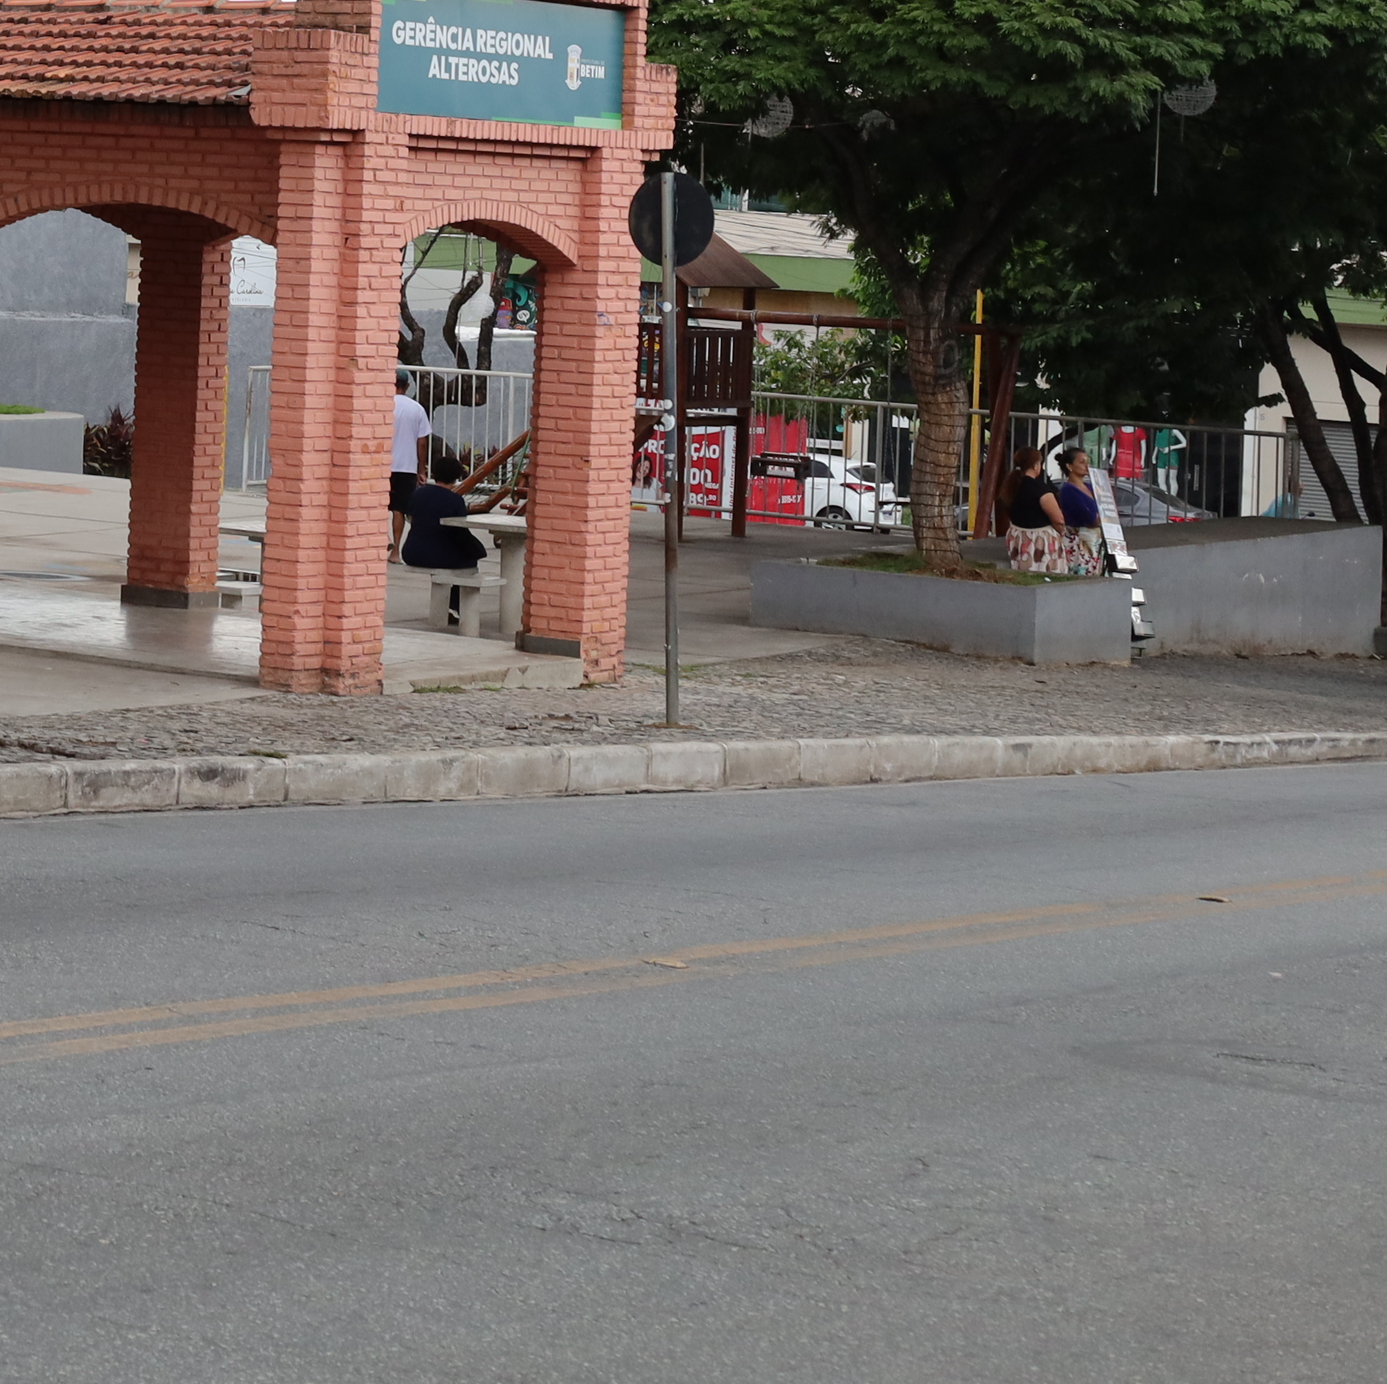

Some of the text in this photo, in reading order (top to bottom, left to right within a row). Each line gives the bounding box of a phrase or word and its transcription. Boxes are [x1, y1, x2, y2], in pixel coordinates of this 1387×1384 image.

[392, 16, 554, 59] GERÊNCIA REGIONAL
[428, 54, 519, 86] ALTEROSAS
[580, 63, 605, 79] BETIM
